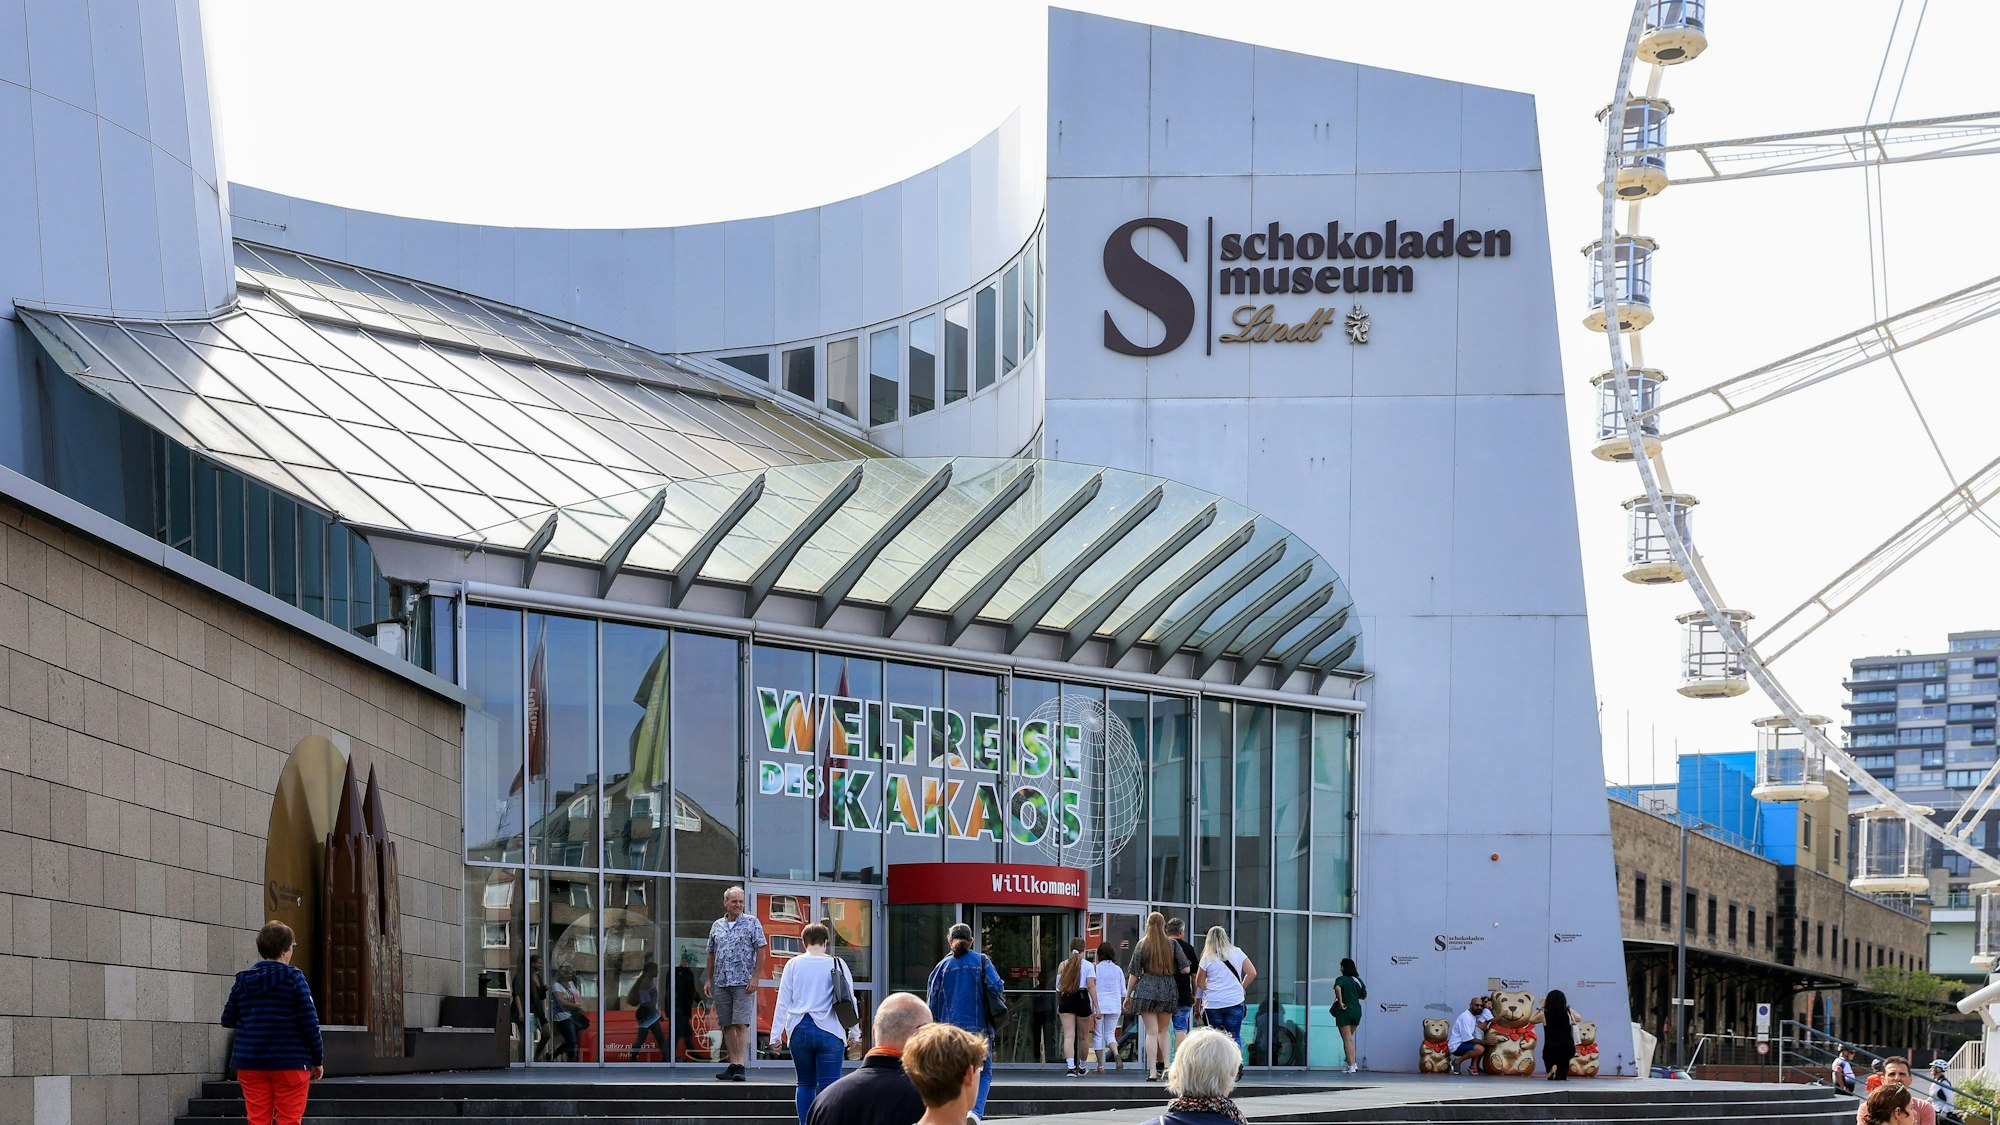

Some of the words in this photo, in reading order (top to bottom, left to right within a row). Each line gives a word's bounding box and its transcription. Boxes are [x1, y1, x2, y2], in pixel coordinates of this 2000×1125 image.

[1219, 218, 1511, 261] schokoladen
[1103, 217, 1195, 356] S
[1219, 263, 1414, 296] museum
[1218, 304, 1336, 343] Lindt
[756, 686, 1082, 782] WELTREISE
[759, 760, 825, 799] DES
[829, 767, 1083, 849] KAKAOS
[992, 873, 1081, 898] Willkommen!
[1434, 934, 1447, 952] S
